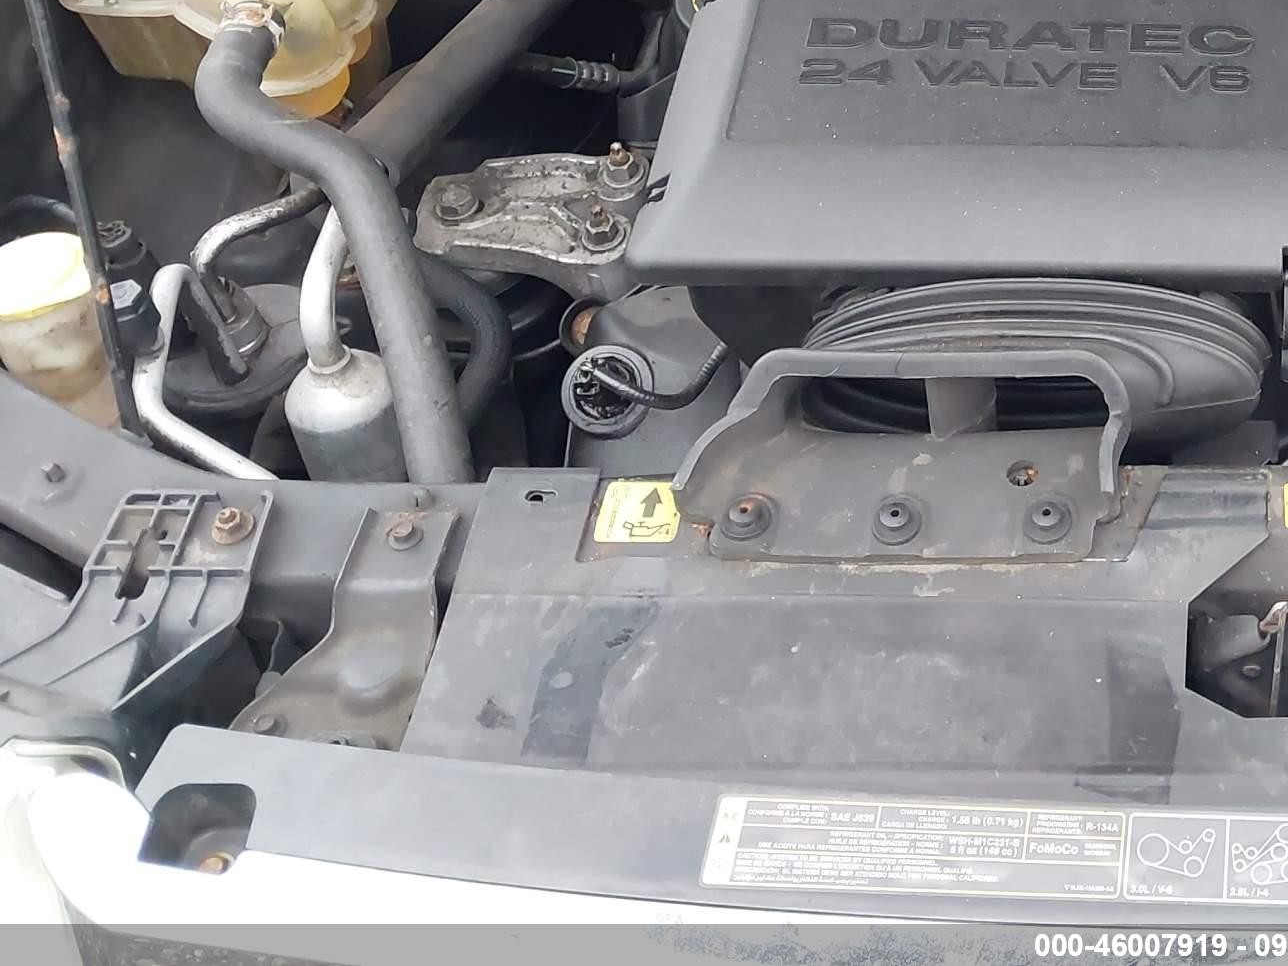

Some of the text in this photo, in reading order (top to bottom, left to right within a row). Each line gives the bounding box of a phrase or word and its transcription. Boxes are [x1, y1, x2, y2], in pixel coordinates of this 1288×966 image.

[804, 17, 1256, 56] DURATEC
[798, 57, 1252, 94] 24 VALVE V6
[830, 812, 851, 822] SAE
[983, 816, 1005, 826] (0.71
[1085, 822, 1119, 832] R-134A
[1029, 842, 1079, 855] FoMoCo
